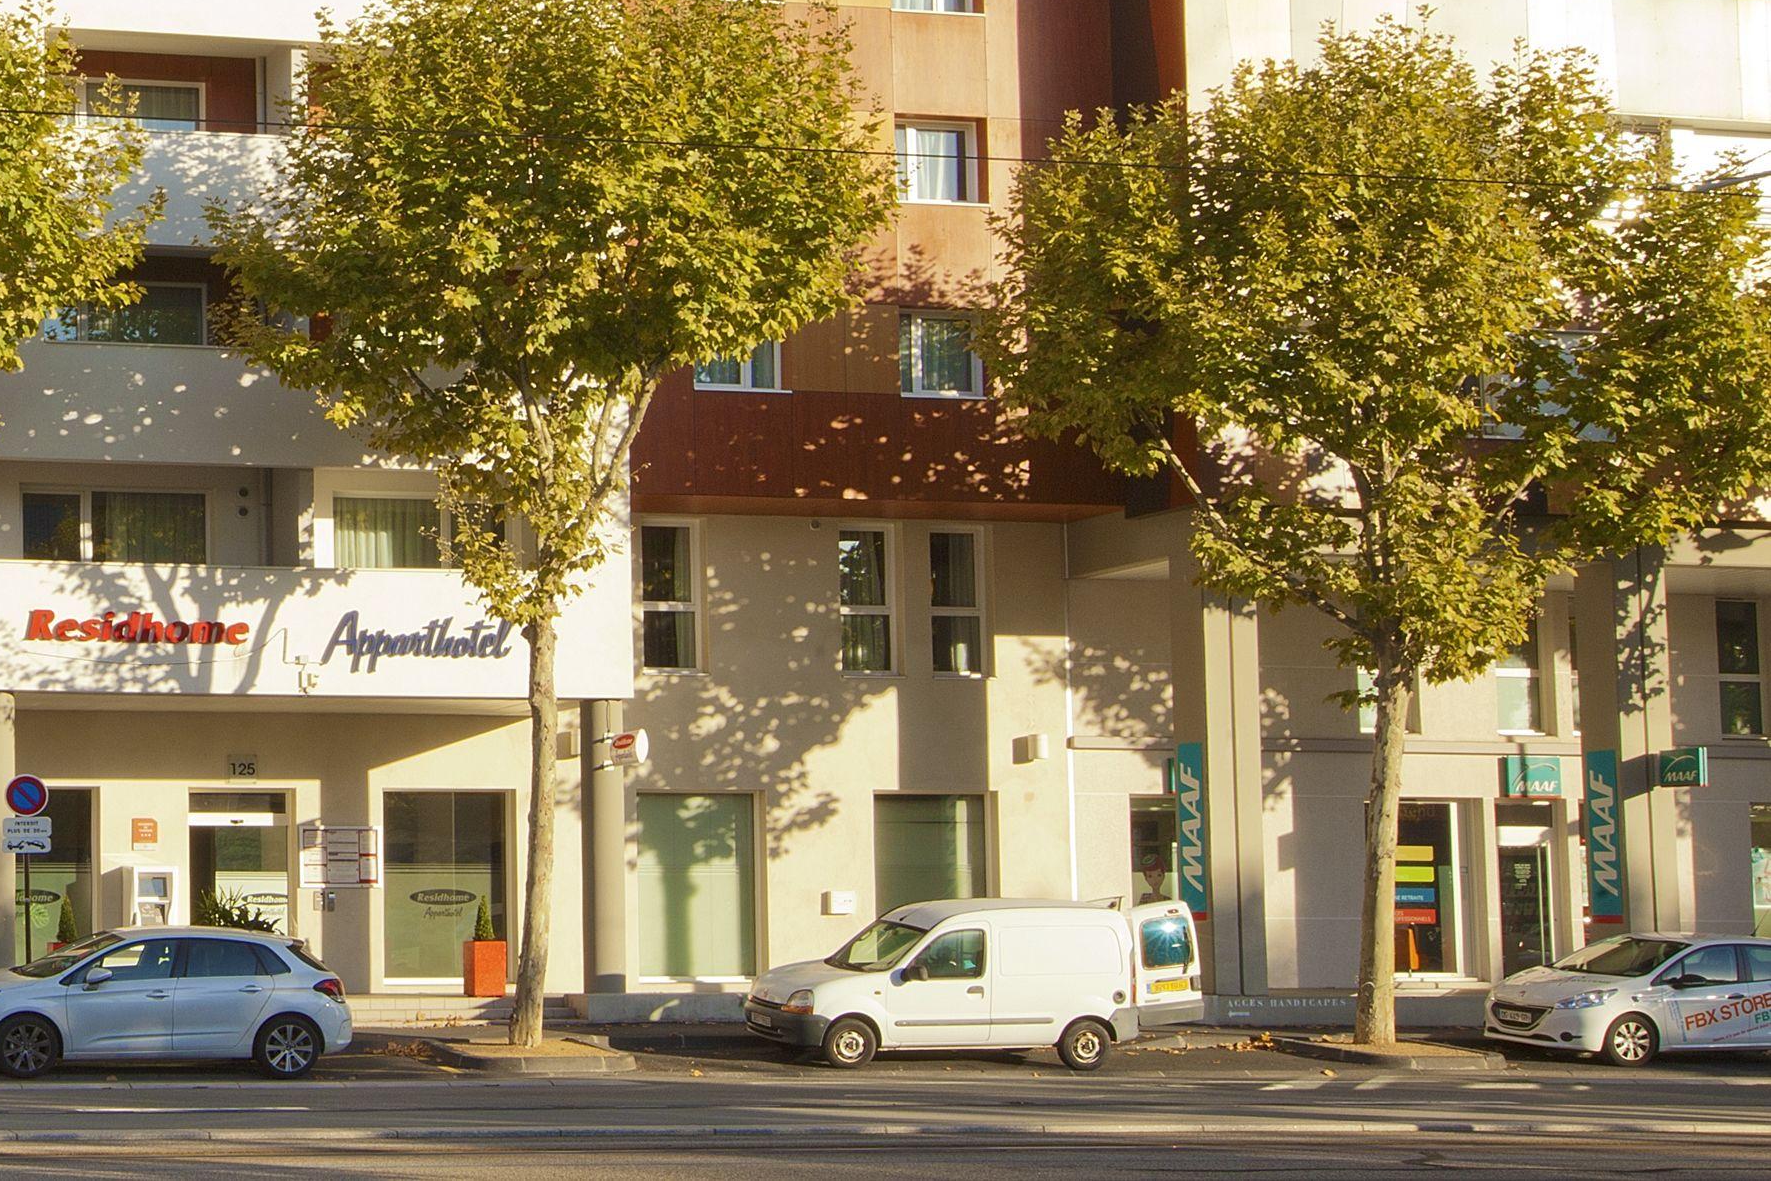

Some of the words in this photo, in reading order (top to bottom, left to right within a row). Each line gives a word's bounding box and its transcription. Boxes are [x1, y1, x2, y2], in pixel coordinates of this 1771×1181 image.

[24, 608, 250, 645] Residhome
[320, 610, 512, 674] Apparthotel
[230, 762, 256, 776] 125
[1663, 770, 1698, 783] MAAF
[1515, 780, 1558, 792] MAAF
[1180, 762, 1204, 893] MAAF
[1589, 769, 1619, 897] MAAF
[417, 892, 470, 902] Residhome
[1684, 1008, 1719, 1031] FBX
